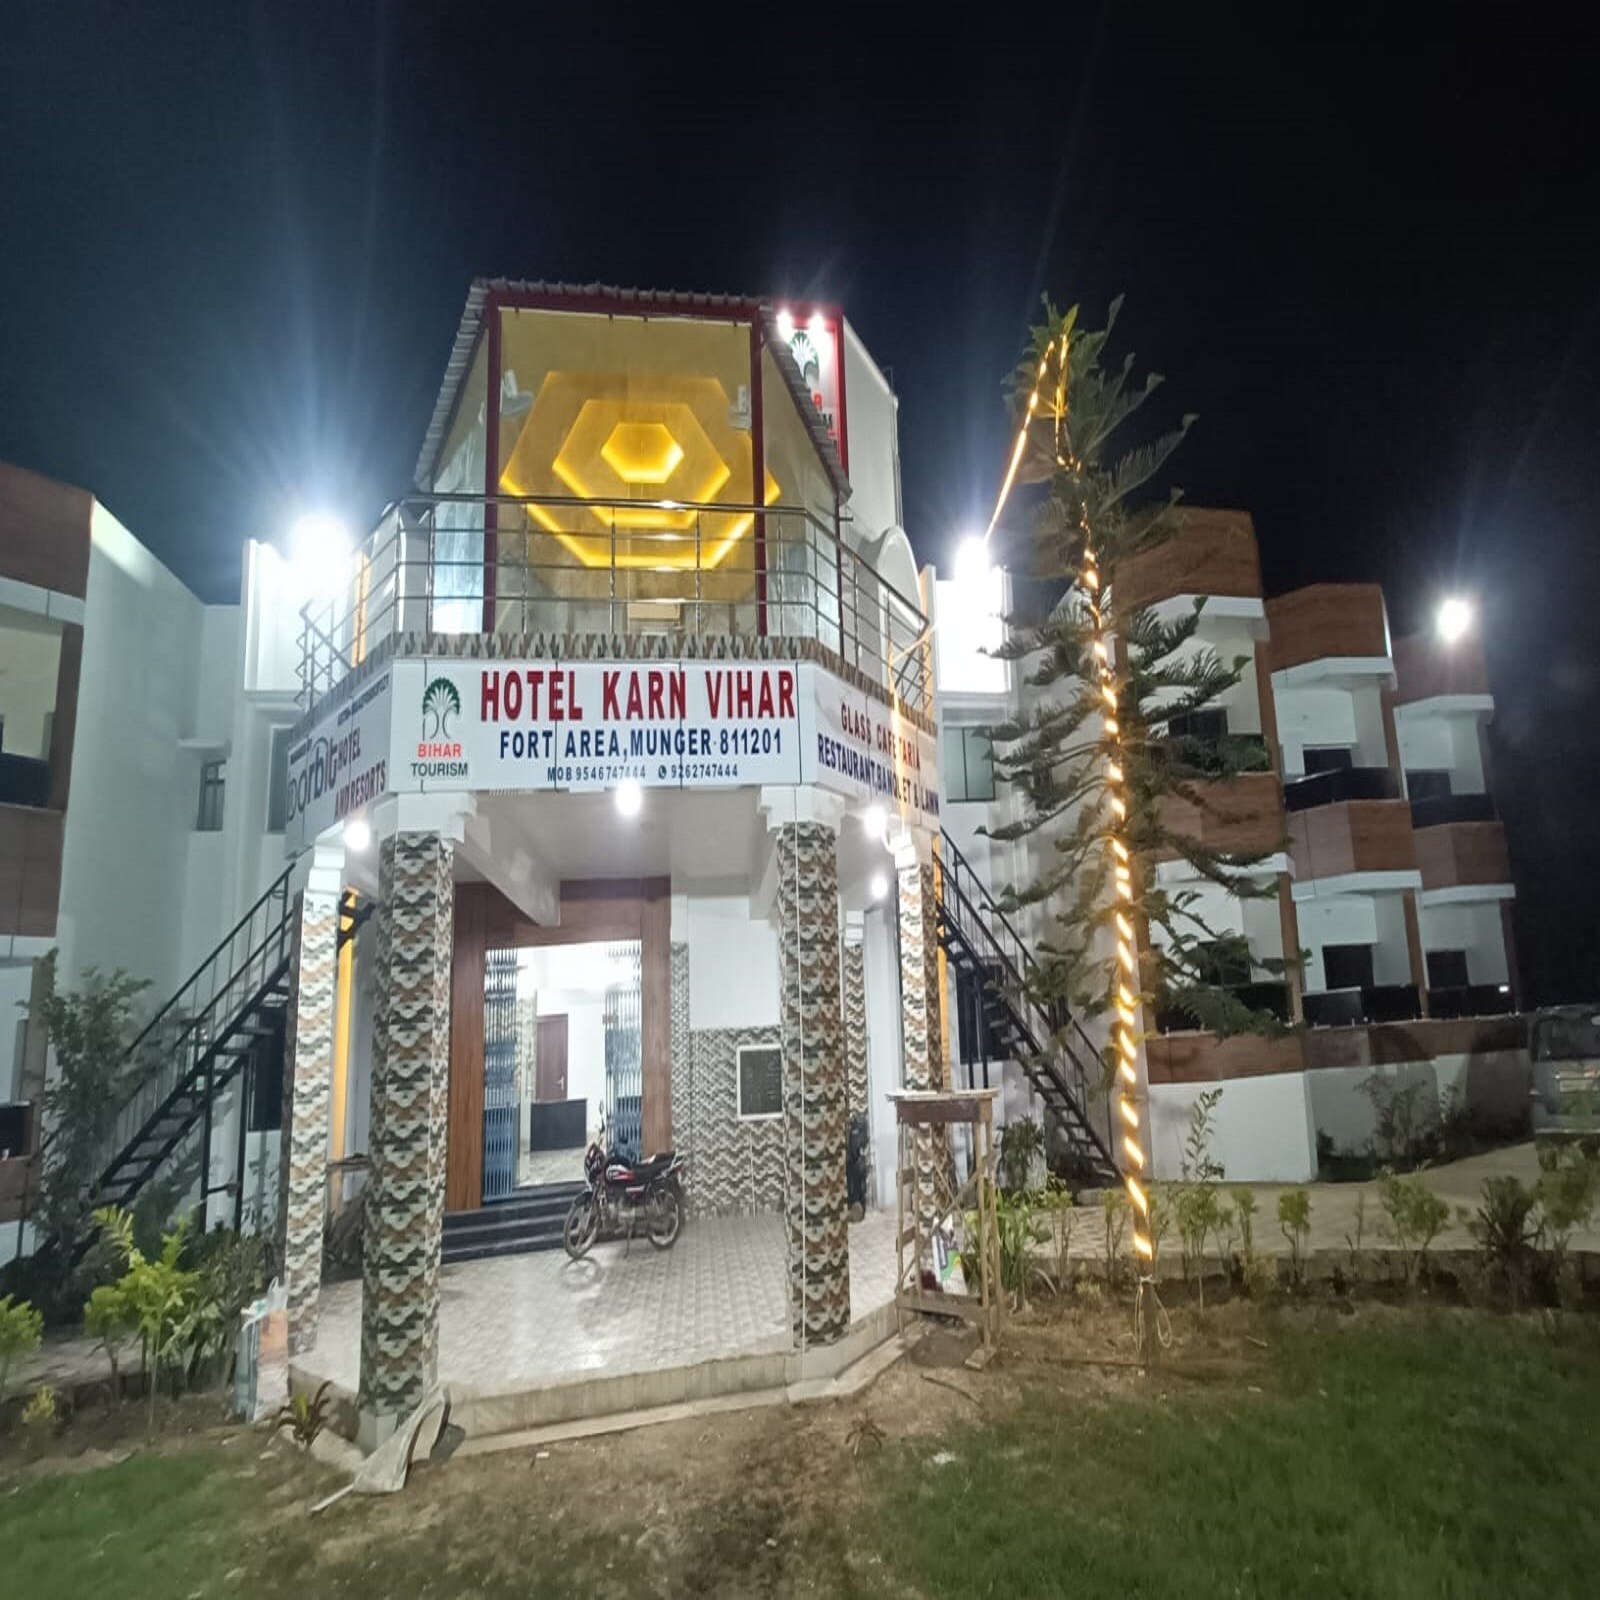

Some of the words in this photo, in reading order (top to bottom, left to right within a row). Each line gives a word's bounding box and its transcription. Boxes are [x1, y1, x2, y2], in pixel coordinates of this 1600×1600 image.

[480, 670, 583, 722] HOTEL
[602, 670, 686, 721] KARN
[704, 670, 796, 720] VIHAR
[840, 702, 872, 746] GLASS
[417, 743, 462, 758] BIHAR
[499, 729, 553, 760] FORT
[410, 762, 469, 777] TOURISM
[547, 766, 572, 782] MOB
